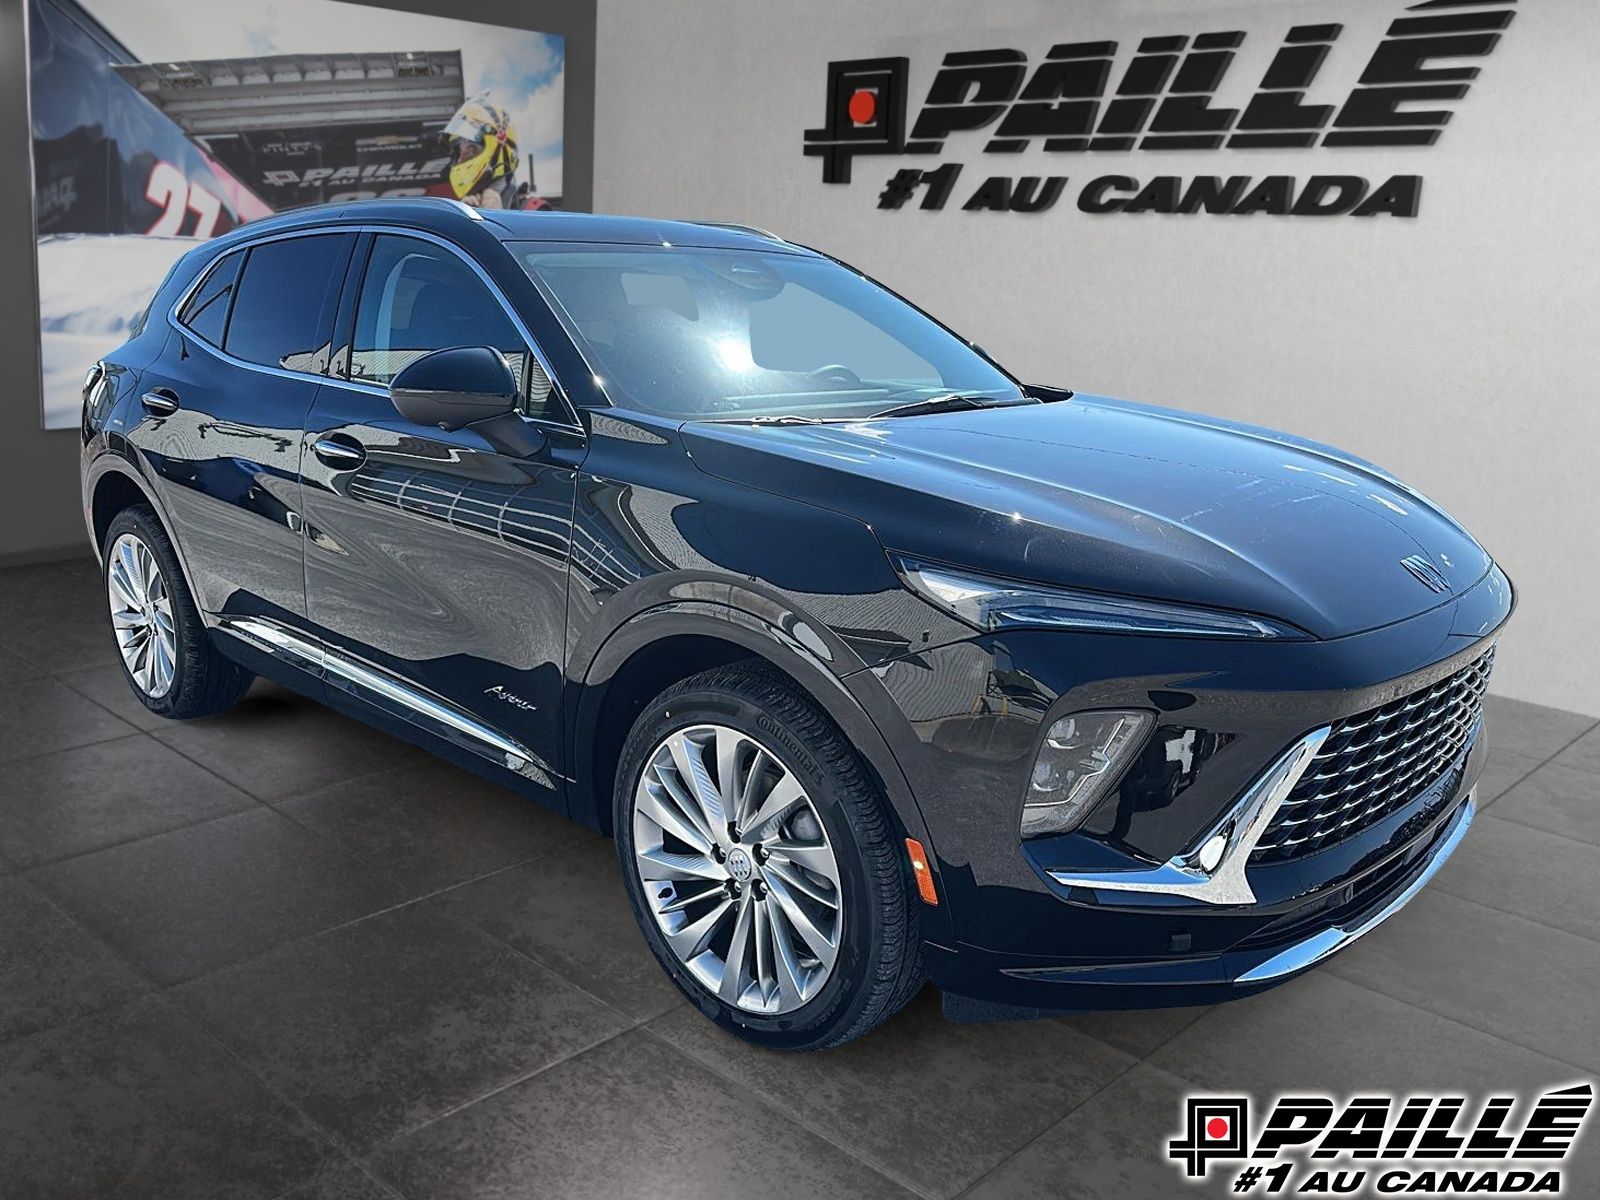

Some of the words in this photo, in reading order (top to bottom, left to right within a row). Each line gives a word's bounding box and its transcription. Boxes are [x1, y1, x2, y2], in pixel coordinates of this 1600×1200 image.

[905, 0, 1517, 154] PAILLÉ
[145, 160, 222, 238] 27
[328, 178, 355, 186] AU
[361, 173, 441, 183] CANADA
[877, 163, 963, 210] #1
[962, 176, 1067, 212] AU
[1076, 173, 1423, 217] CANADA
